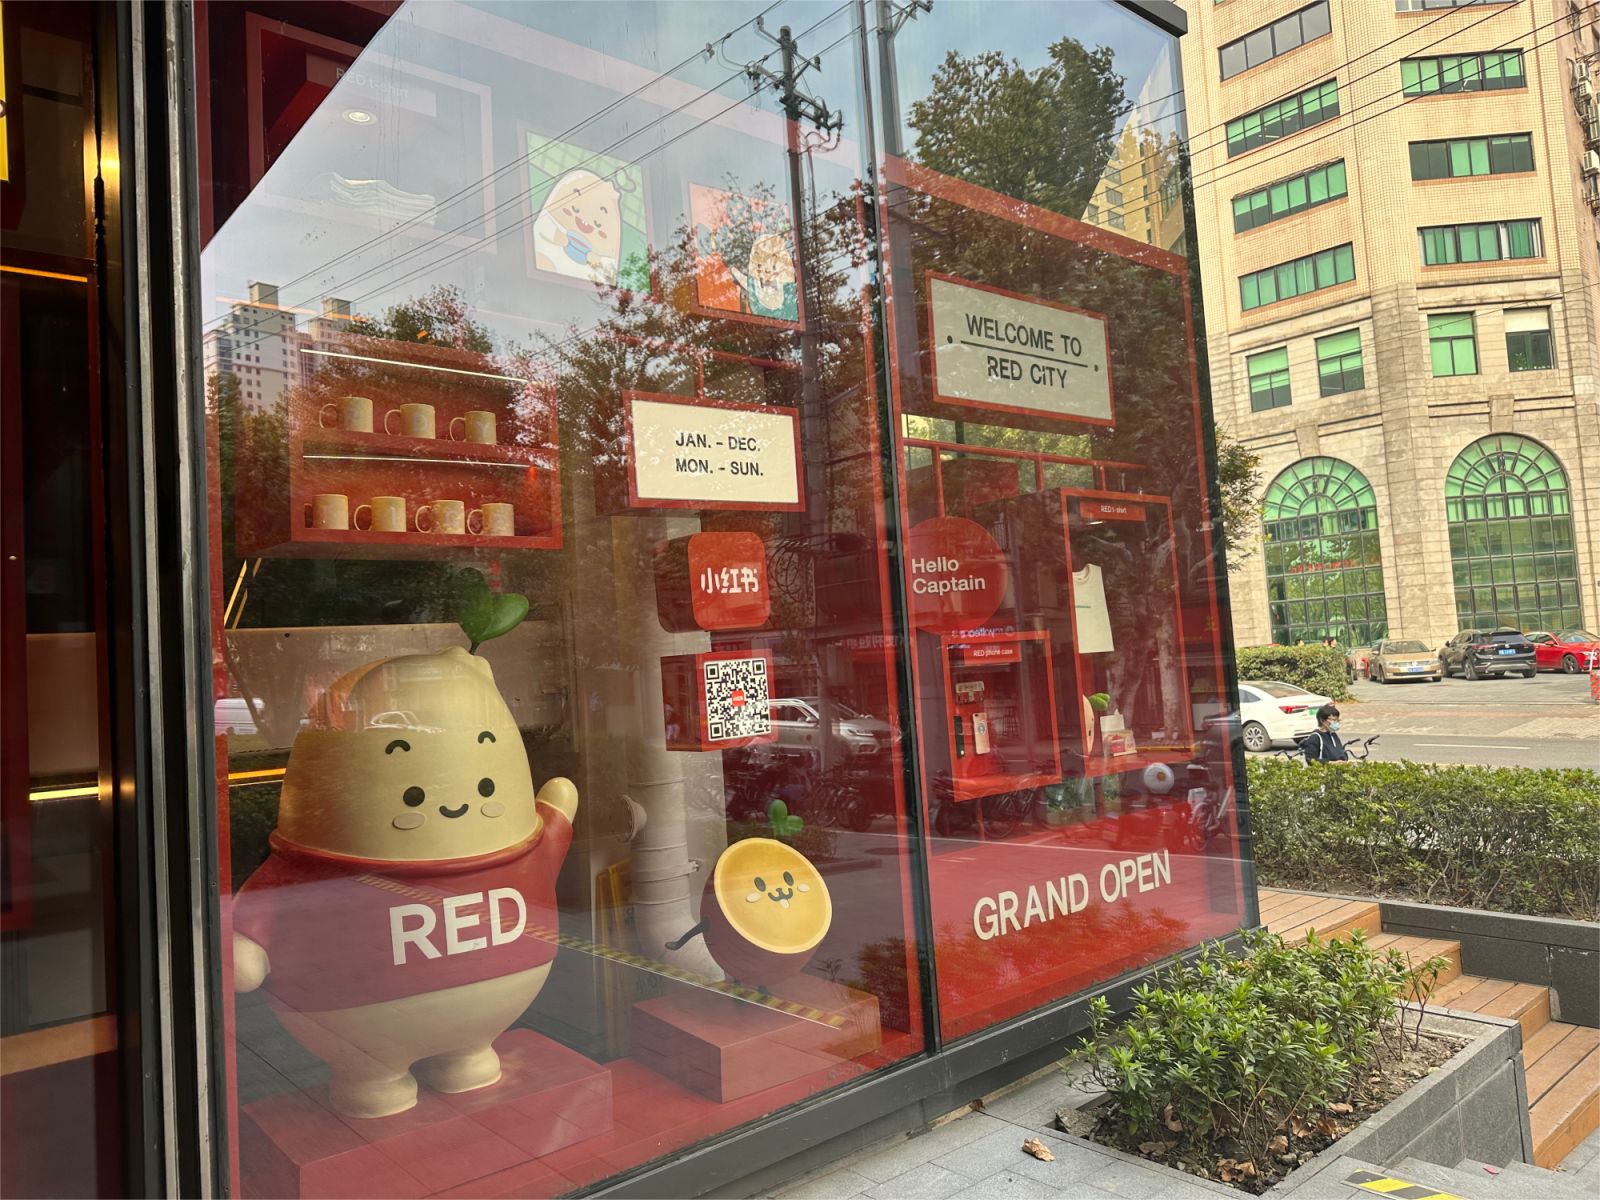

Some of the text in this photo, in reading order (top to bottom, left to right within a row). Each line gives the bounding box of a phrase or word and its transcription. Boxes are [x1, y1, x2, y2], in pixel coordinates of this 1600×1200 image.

[335, 67, 366, 87] RED
[965, 313, 1082, 357] WELCOME TO
[987, 355, 1068, 389] RED CITY
[675, 432, 712, 449] JAN.
[728, 436, 761, 452] DEC.
[675, 458, 714, 474] MON.
[730, 461, 764, 477] SUN.
[911, 556, 959, 574] Hello
[700, 566, 759, 595] 小红书
[912, 575, 986, 596] Captain
[973, 649, 985, 657] RED
[973, 849, 1171, 941] GRAND OPEN
[389, 887, 527, 966] RED
